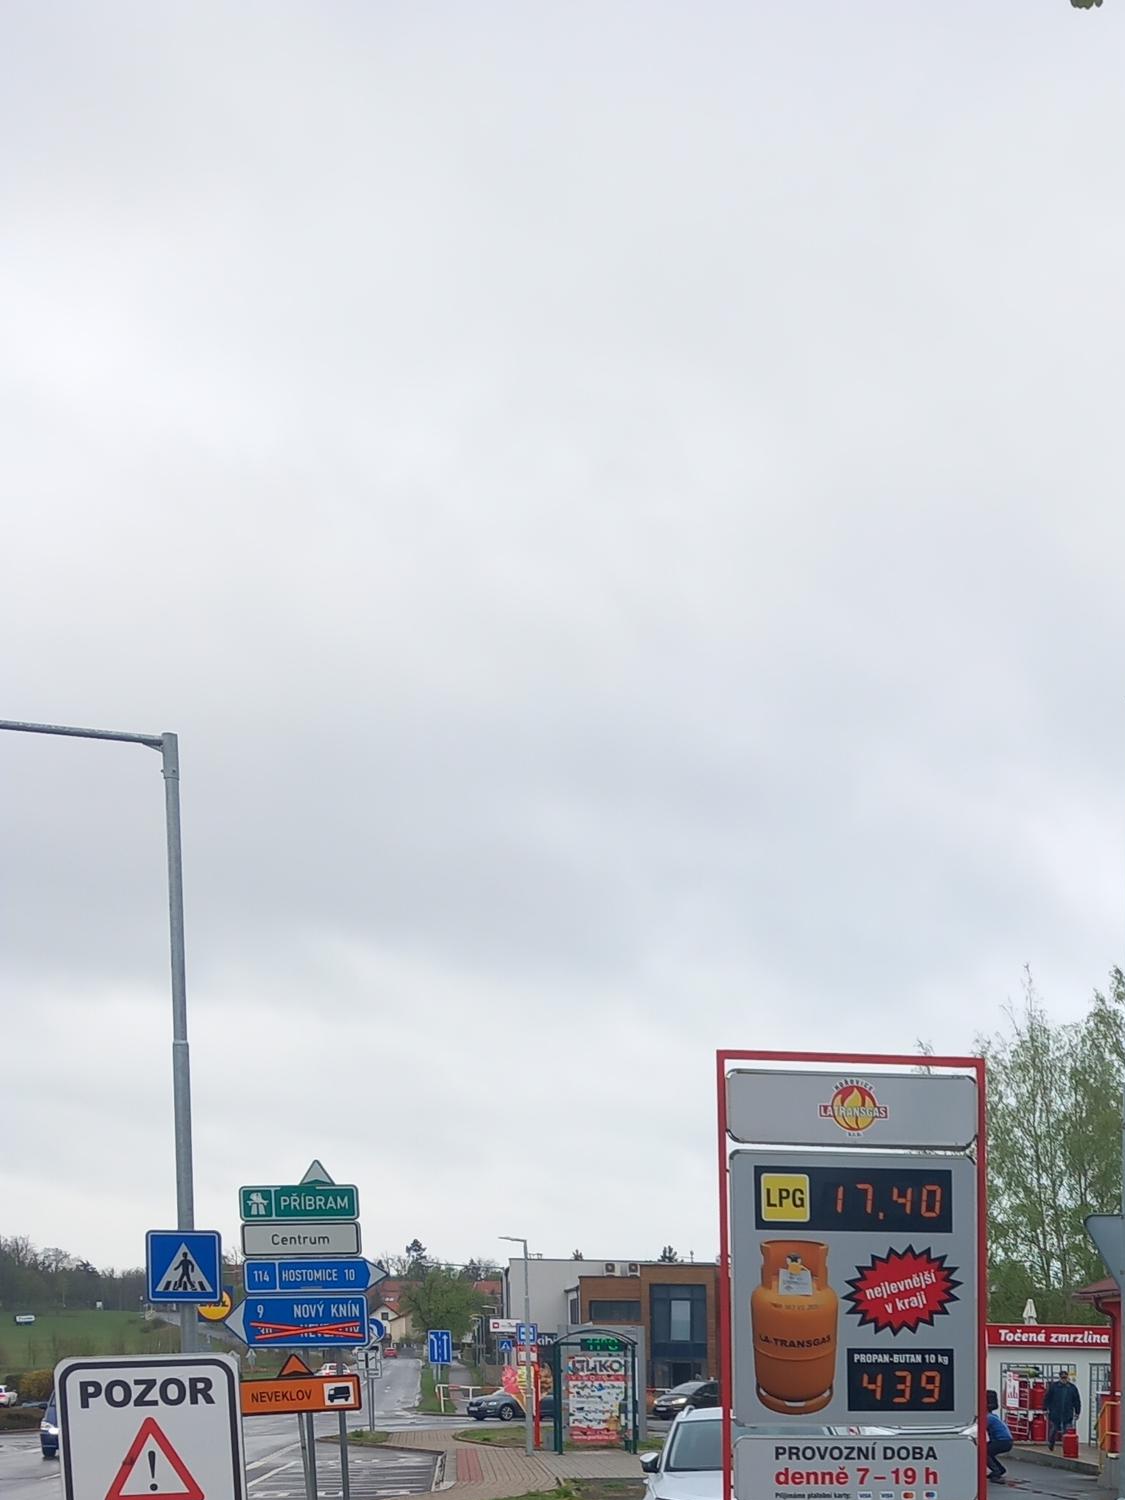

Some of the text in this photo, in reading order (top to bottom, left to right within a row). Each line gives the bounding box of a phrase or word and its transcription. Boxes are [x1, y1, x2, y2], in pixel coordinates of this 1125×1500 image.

[280, 1193, 349, 1210] PŘÍBRAM
[766, 1183, 943, 1220] LPG 17.40
[271, 1233, 330, 1246] Centrum
[253, 1268, 356, 1283] 114 HOSTOMICE 10
[865, 1269, 937, 1300] nejlevnější
[256, 1300, 360, 1319] 9 NOVÝ KNÍN
[885, 1291, 927, 1314] v kraji
[999, 1329, 1109, 1344] Točená zmrzlina
[854, 1353, 949, 1365] PROPAN-BUTAN 10 kg
[79, 1376, 216, 1409] POZOR
[250, 1389, 313, 1403] NEVEKLOV
[862, 1370, 942, 1404] 439
[774, 1442, 938, 1460] PROVOZNÍ DOBA
[774, 1466, 849, 1485] denně
[925, 1467, 939, 1485] h
